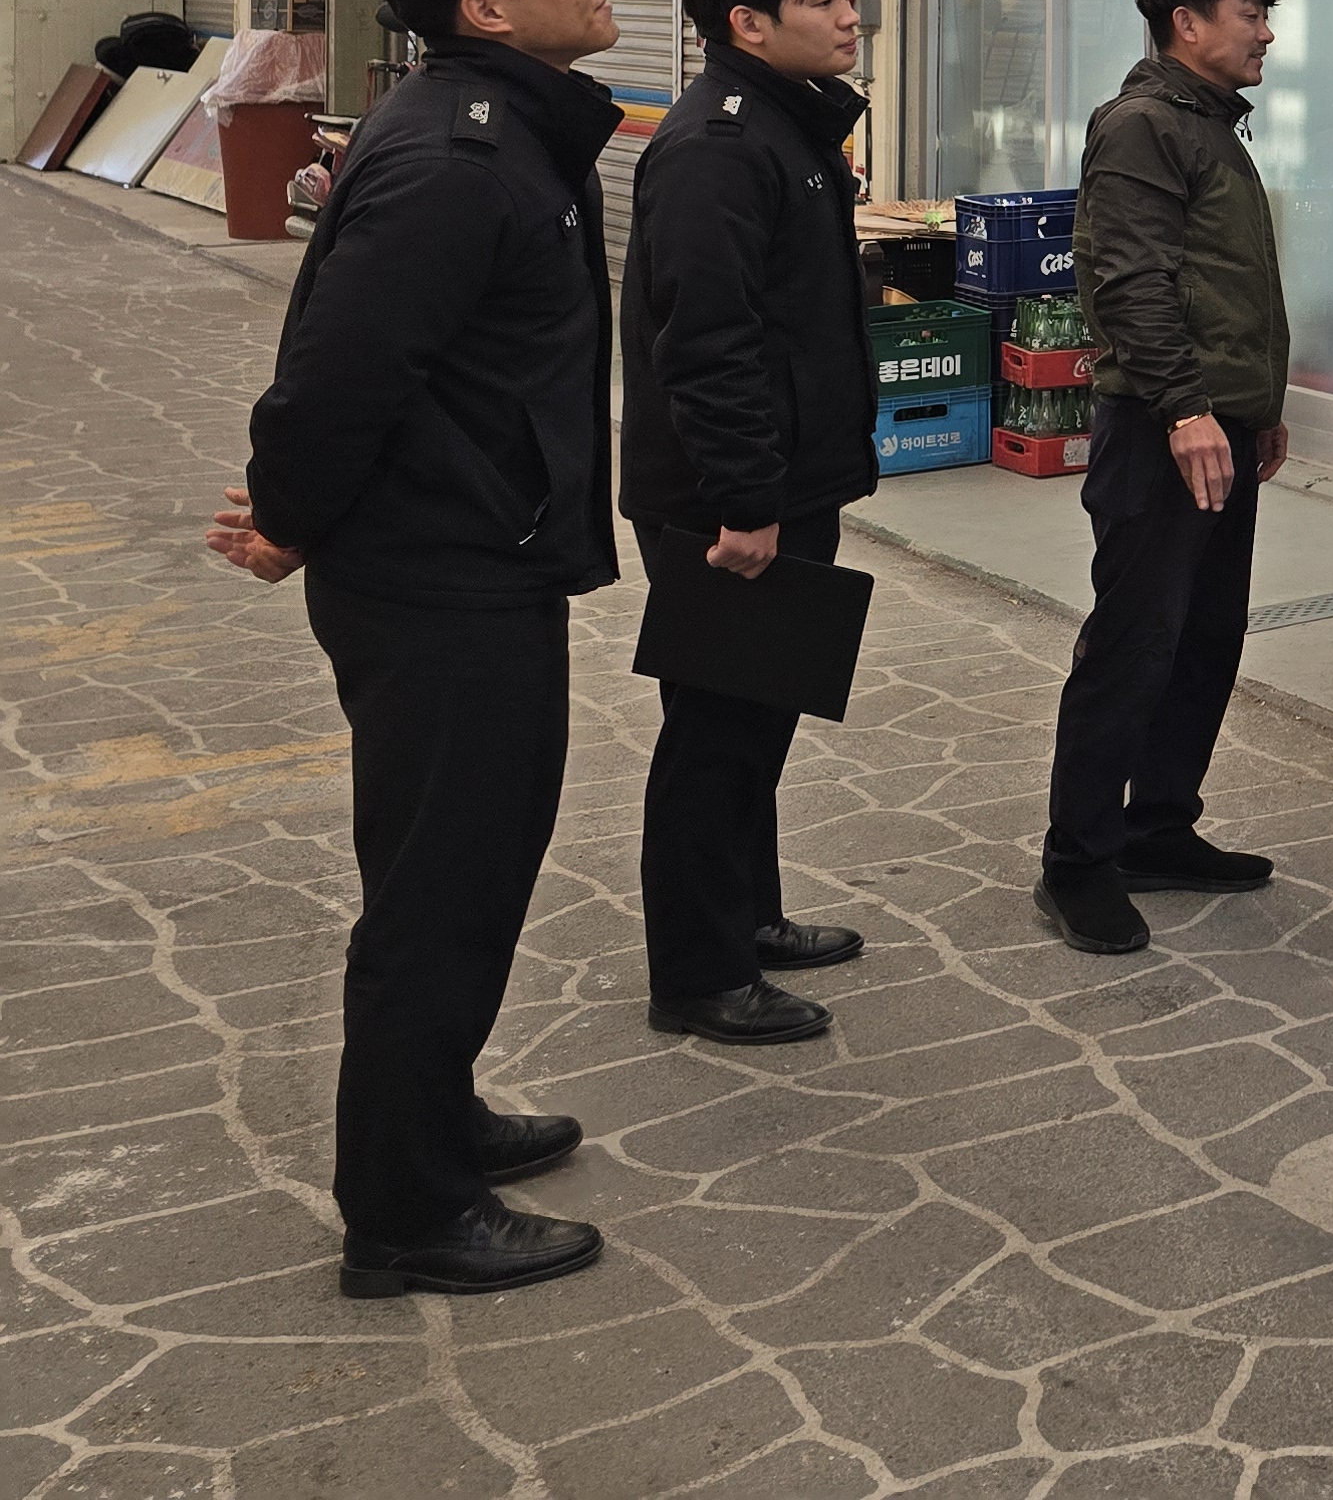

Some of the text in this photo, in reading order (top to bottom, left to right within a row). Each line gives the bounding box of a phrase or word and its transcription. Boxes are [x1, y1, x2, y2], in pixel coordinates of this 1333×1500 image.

[967, 249, 984, 268] Cass
[1040, 251, 1075, 276] Cas
[878, 354, 962, 384] 좋은데이
[900, 431, 962, 452] 하이트진로
